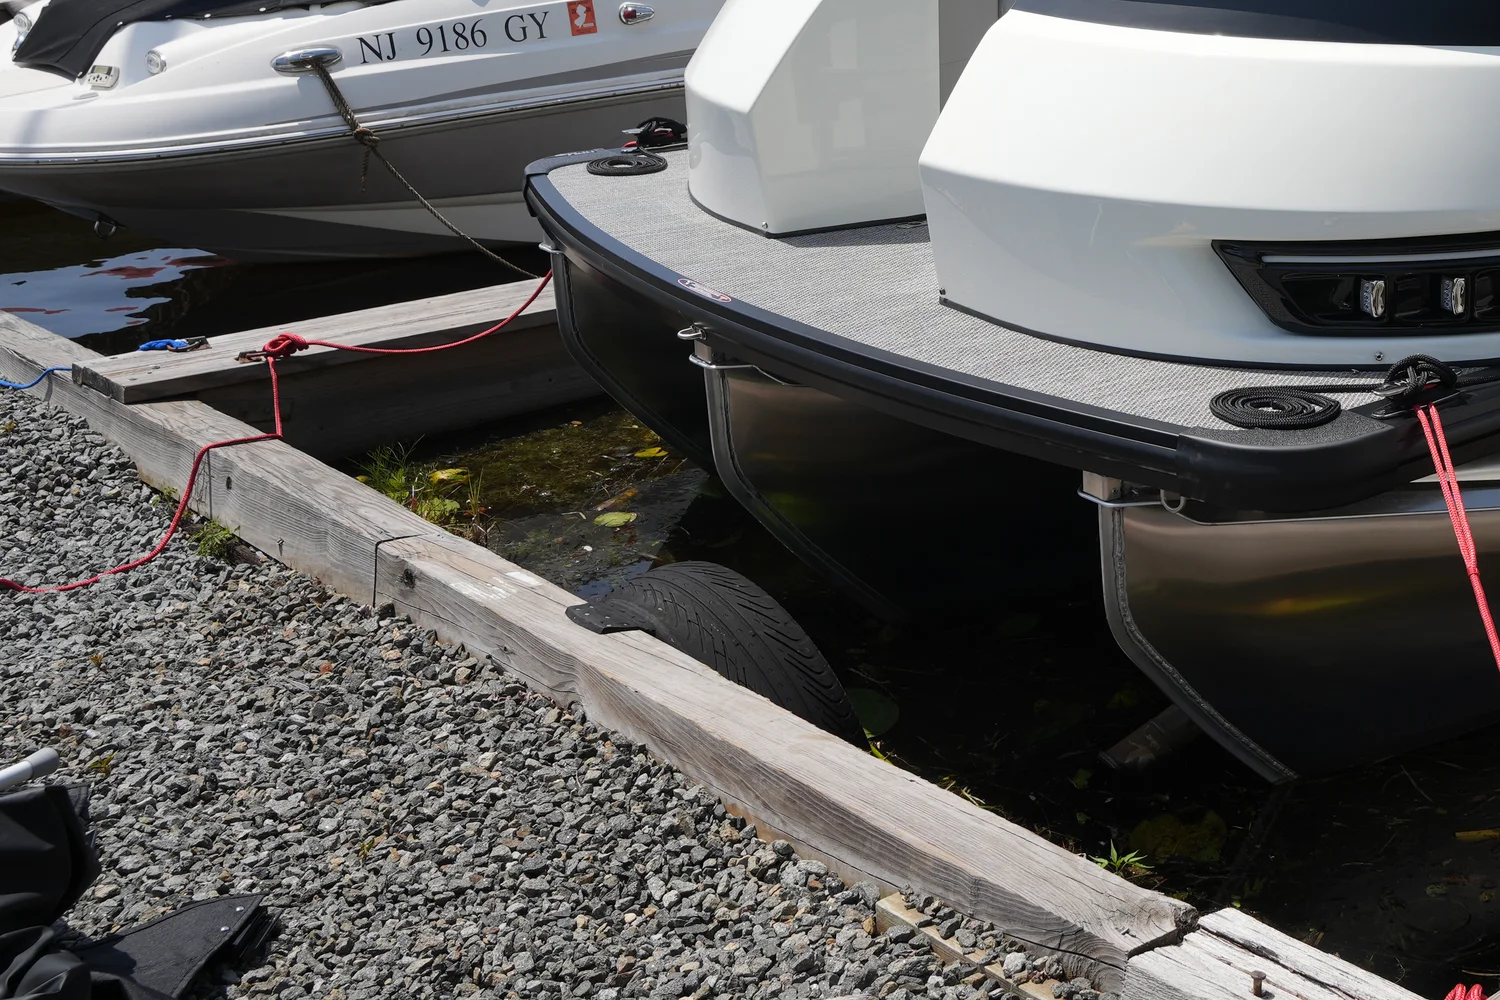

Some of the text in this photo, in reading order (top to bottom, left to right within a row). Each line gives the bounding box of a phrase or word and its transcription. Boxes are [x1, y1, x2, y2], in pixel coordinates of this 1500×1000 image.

[356, 11, 550, 64] NJ 9186 GY
